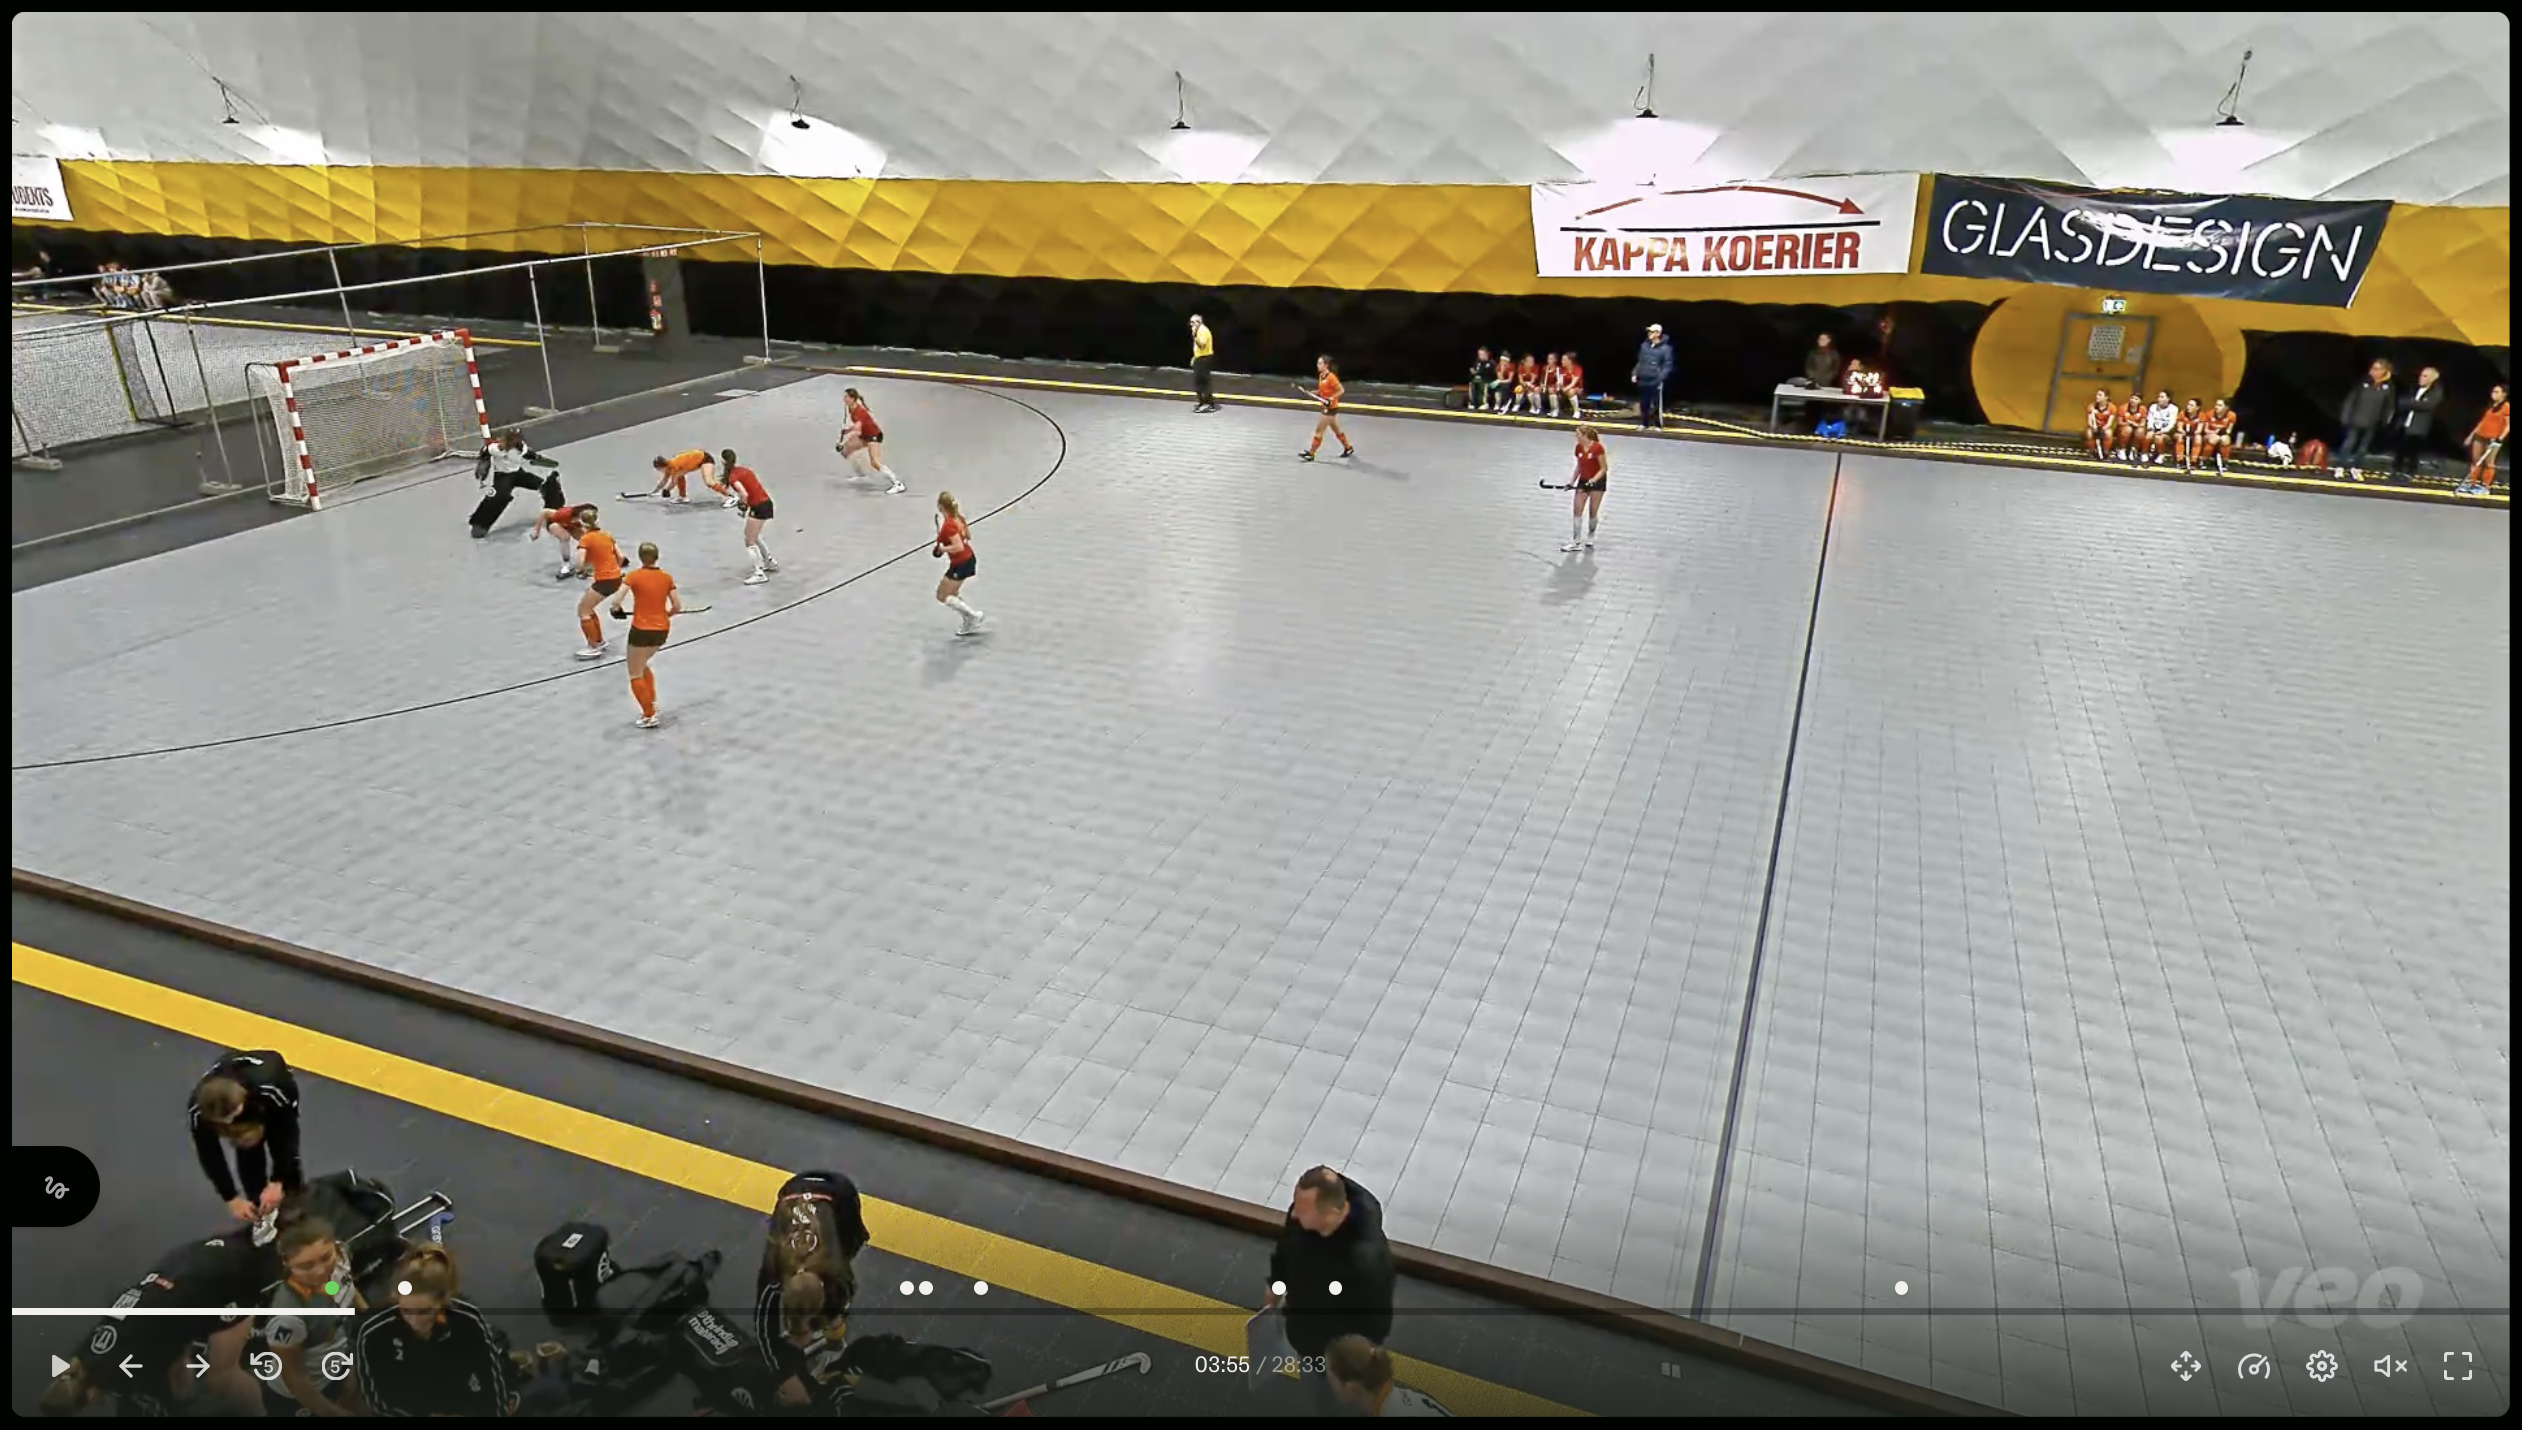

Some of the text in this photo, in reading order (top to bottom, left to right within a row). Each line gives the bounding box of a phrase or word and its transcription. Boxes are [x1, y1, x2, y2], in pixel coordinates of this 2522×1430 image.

[1574, 232, 1860, 272] KAPPA KOERIER
[1943, 200, 2363, 281] GLASDESIGN
